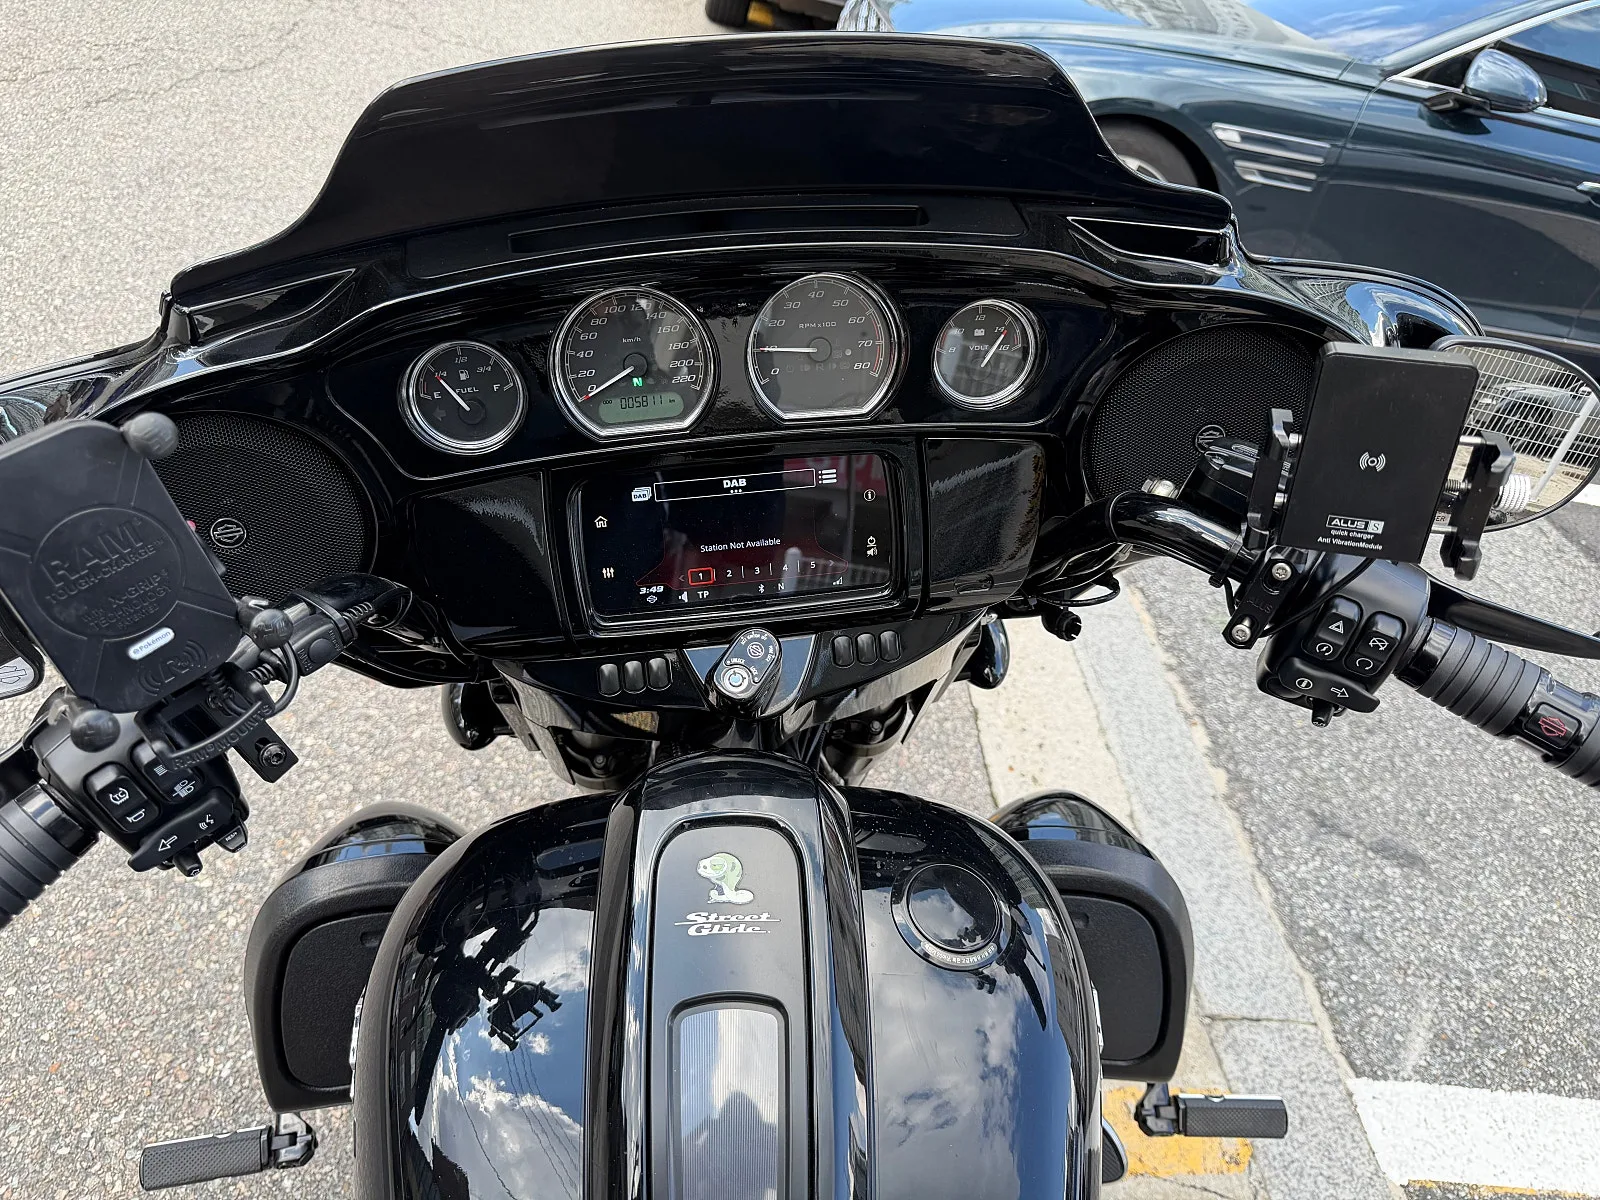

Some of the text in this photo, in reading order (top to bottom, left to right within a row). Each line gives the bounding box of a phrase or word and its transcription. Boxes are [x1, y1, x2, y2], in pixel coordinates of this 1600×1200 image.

[808, 290, 825, 298] 40
[630, 303, 652, 311] 120
[783, 301, 801, 309] 30
[832, 299, 849, 307] 50
[604, 305, 627, 314] 100
[645, 311, 667, 320] 140
[590, 317, 607, 326] 80
[768, 319, 785, 327] 20
[848, 316, 865, 324] 60
[657, 325, 680, 333] 160
[580, 332, 598, 340] 60
[668, 342, 690, 350] 180
[576, 350, 594, 358] 40
[669, 359, 694, 368] 200
[853, 362, 871, 370] 80
[576, 369, 596, 378] 20
[632, 377, 643, 387] N
[671, 375, 696, 384] 220
[455, 386, 479, 394] FUEL
[493, 384, 501, 392] F
[587, 384, 597, 392] 0
[433, 391, 442, 399] E
[620, 395, 664, 409] 005811
[723, 478, 747, 488] DAB
[1331, 518, 1366, 529] ALUS
[1349, 531, 1374, 540] charger
[1317, 536, 1331, 544] Anti
[700, 537, 781, 553] Station Not Available
[754, 566, 761, 574] 3
[810, 561, 816, 569] 5
[639, 585, 664, 595] 3:49
[777, 583, 785, 591] N
[697, 591, 709, 599] TP
[138, 630, 171, 653] Pokémon
[113, 790, 126, 800] TC
[680, 912, 777, 923] Street
[687, 924, 767, 936] Glide
